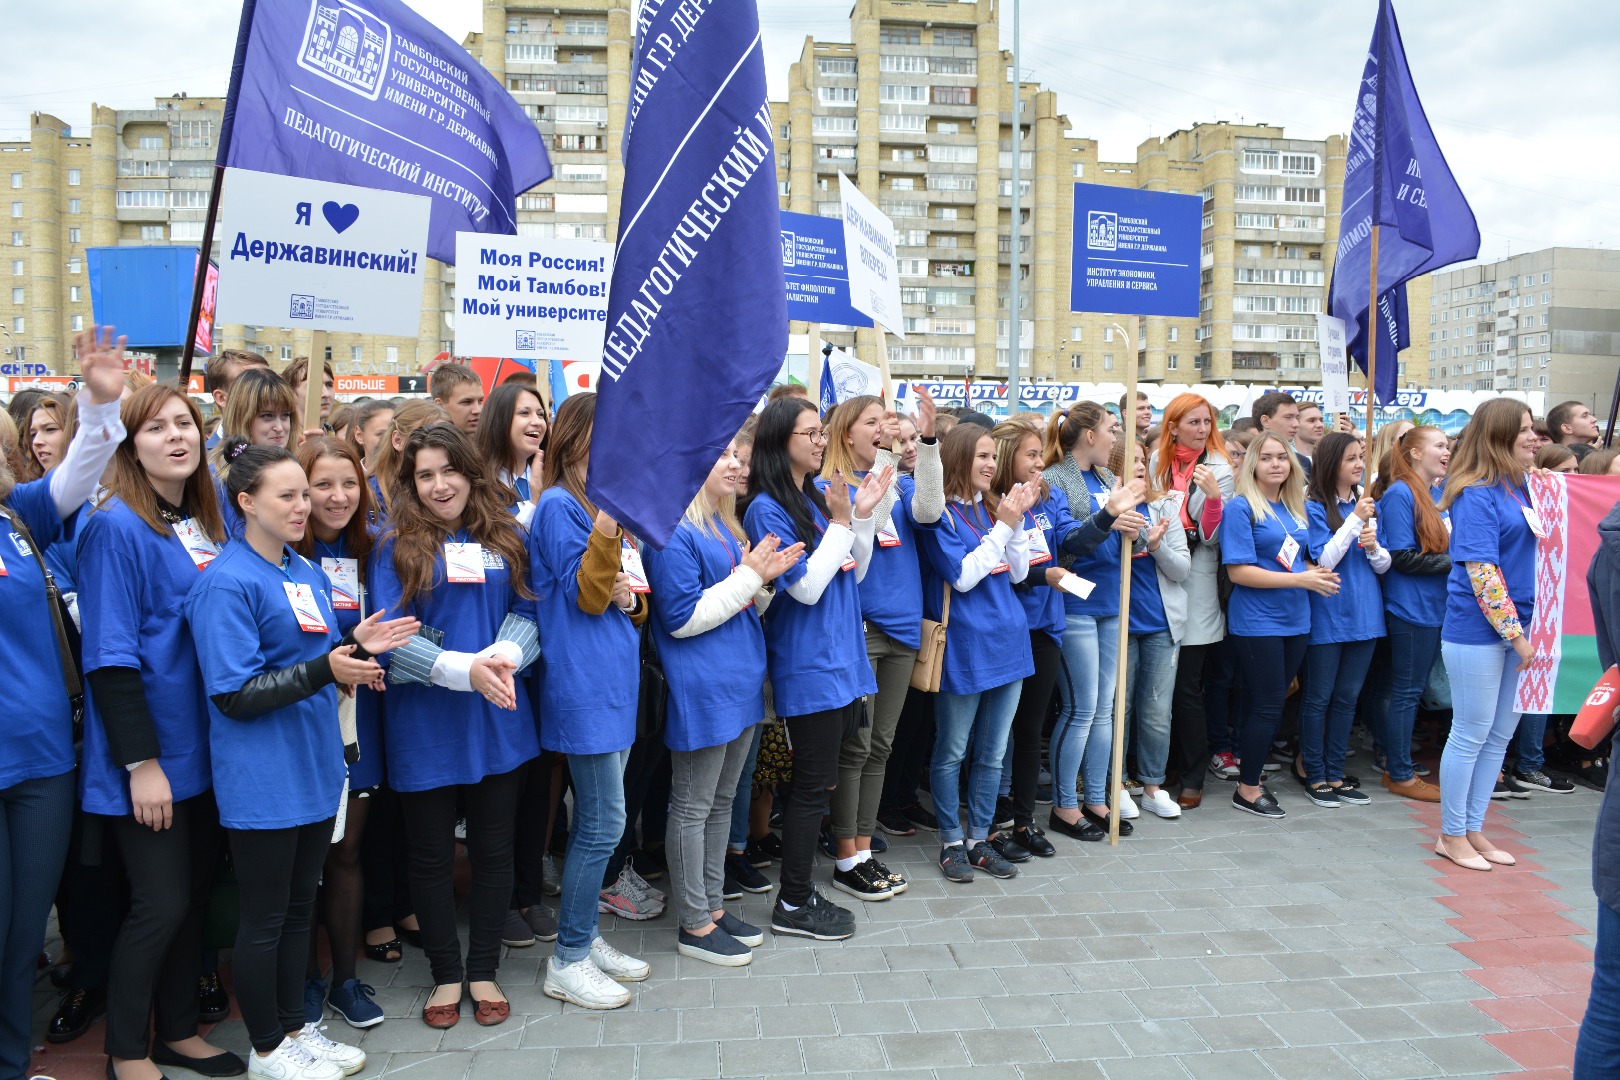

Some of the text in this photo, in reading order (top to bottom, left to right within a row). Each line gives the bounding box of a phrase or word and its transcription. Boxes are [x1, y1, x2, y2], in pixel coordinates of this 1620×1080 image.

[395, 34, 469, 85] ТАМБОВСКИЙ
[391, 67, 467, 120] УНИВЕРСИТЕТ
[394, 50, 491, 125] ГОСУДАРСТВЕННЫЙ
[384, 86, 426, 116] ИМЕНИ
[428, 107, 445, 127] Г.Р.
[284, 107, 490, 223] ПЕДАГОГИЧЕСКИЙ ИНСТИТУТ
[295, 201, 312, 226] Я
[231, 231, 418, 274] Державинский!
[480, 248, 605, 273] Моя Россия!
[601, 126, 769, 382] ПЕДАГОГИЧЕСКИЙ
[1087, 267, 1117, 277] ИНСТИТУТ
[1087, 278, 1125, 289] УПРАВЛЕНИЯ
[1132, 280, 1158, 291] СЕРВИСА
[478, 274, 606, 298] Мой Тамбов!
[800, 284, 836, 294] ФИЛОЛОГИИ
[463, 298, 608, 322] Мой университе
[335, 362, 411, 375] САЛОН
[338, 380, 386, 390] БОЛЬШЕ
